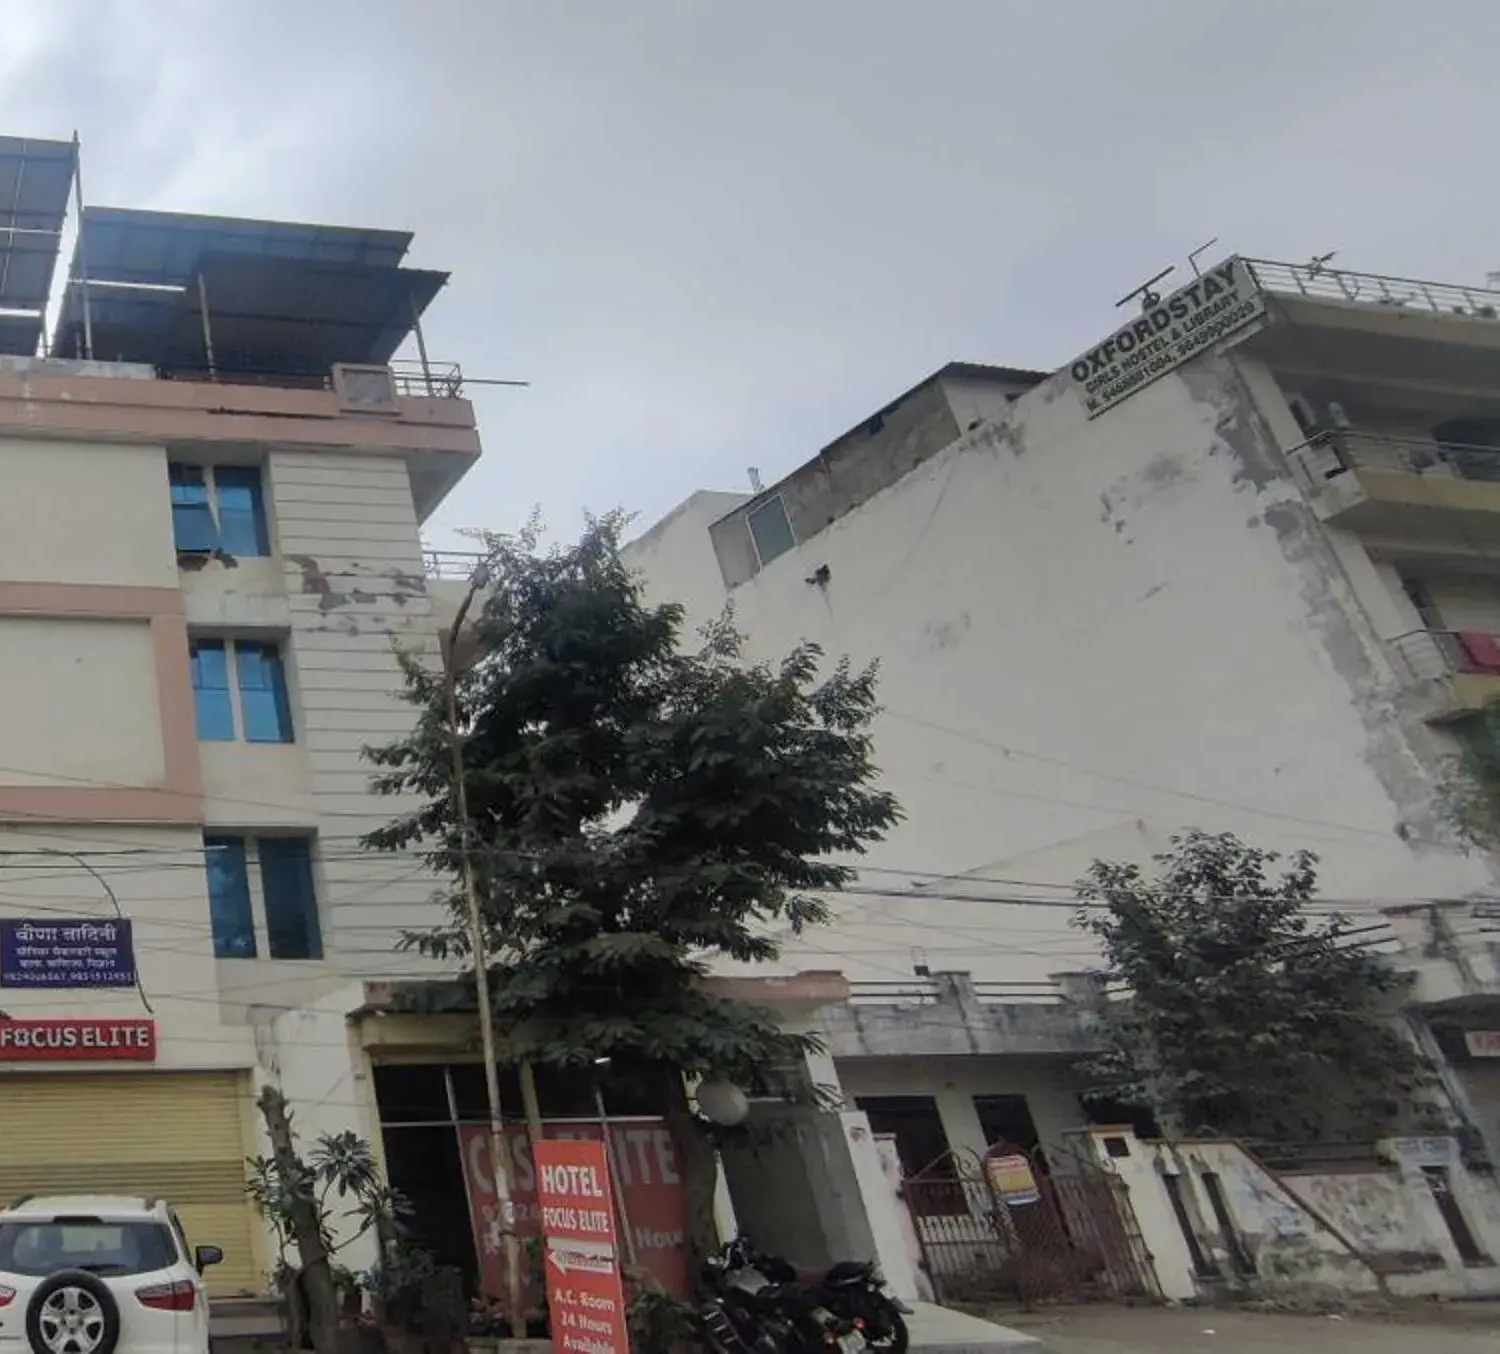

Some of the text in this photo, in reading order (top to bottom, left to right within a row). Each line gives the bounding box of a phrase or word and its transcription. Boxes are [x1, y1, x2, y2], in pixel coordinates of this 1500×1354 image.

[1071, 260, 1237, 382] OXFORDSTAY
[1085, 363, 1121, 394] GIRLS
[1122, 335, 1170, 373] HOSTEL
[1182, 288, 1240, 334] LIBRARY
[0, 1026, 150, 1048] FOCUS ELITE
[540, 1163, 604, 1197] HOTEL
[543, 1206, 577, 1231] FOCUS
[578, 1209, 610, 1234] ELITE
[579, 1291, 616, 1313] Room
[578, 1313, 613, 1335] Hours
